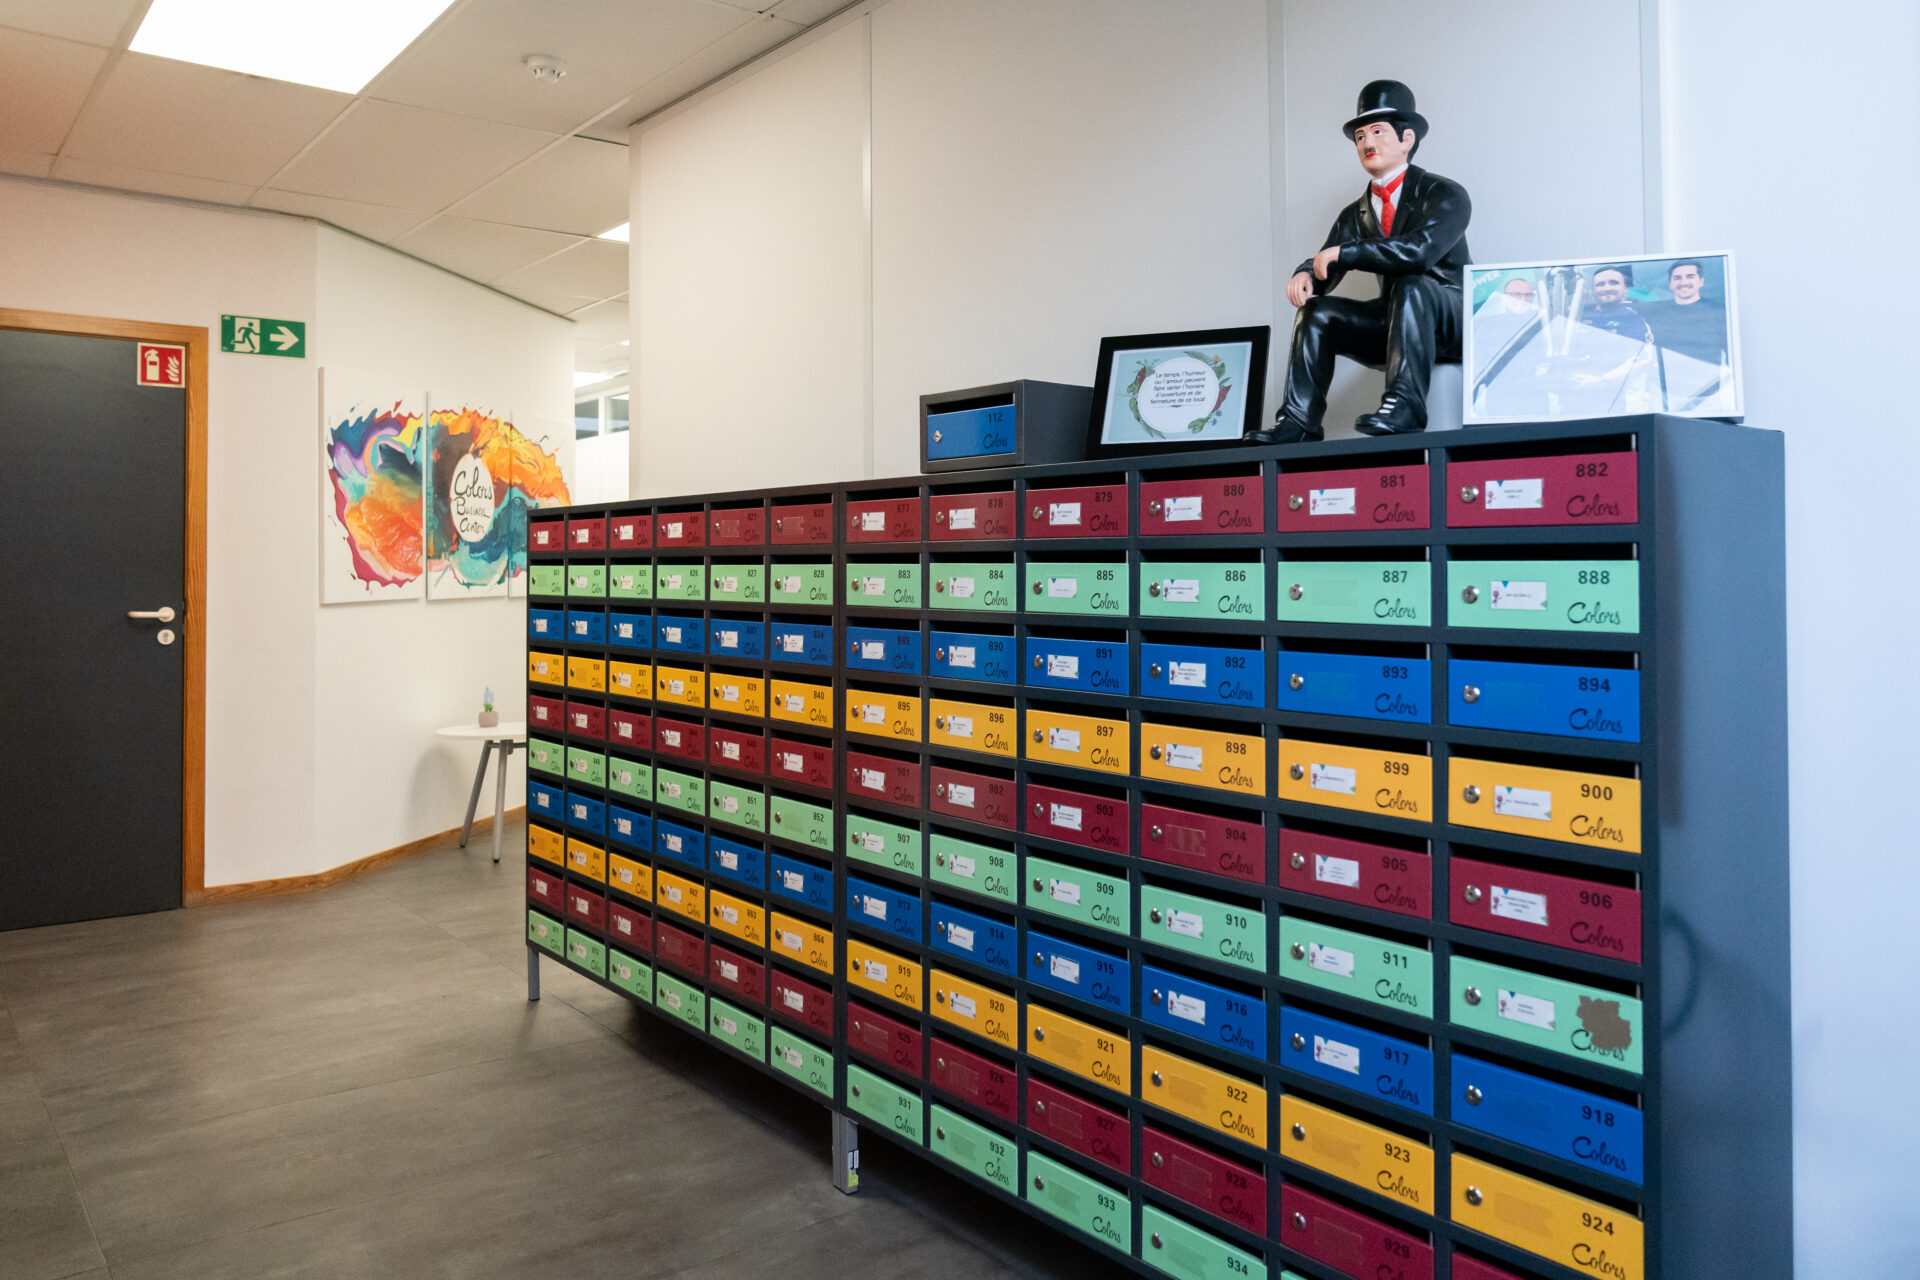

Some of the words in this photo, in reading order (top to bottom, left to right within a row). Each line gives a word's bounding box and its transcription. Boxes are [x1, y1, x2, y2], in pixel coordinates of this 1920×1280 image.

[988, 412, 1002, 423] 112
[983, 432, 1008, 449] Colors
[1575, 462, 1608, 478] 882
[454, 466, 493, 500] Colors
[1223, 484, 1245, 496] 880
[1380, 474, 1405, 488] 881
[988, 498, 1003, 508] 878
[1094, 491, 1112, 503] 879
[1566, 493, 1619, 517] Colors
[1217, 509, 1251, 528] Colors
[1373, 502, 1415, 523] Colors
[984, 519, 1009, 534] Colors
[1089, 514, 1118, 531] Colors
[897, 569, 910, 579] 883
[988, 569, 1003, 579] 884
[1096, 570, 1114, 580] 885
[1224, 570, 1246, 582] 886
[1382, 570, 1408, 583] 887
[1577, 570, 1610, 585] 888
[744, 586, 760, 598] Colors
[809, 587, 827, 600] Colors
[893, 589, 914, 603] Colors
[984, 590, 1008, 605] Colors
[1090, 592, 1119, 609] Colors
[1218, 595, 1252, 613] Colors
[1374, 598, 1416, 618] Colors
[1567, 601, 1620, 624] Colors
[988, 640, 1003, 652] 890
[1095, 647, 1112, 659] 891
[984, 661, 1008, 677] Colors
[1224, 655, 1245, 669] 892
[1090, 670, 1119, 688] Colors
[1382, 665, 1408, 680] 893
[1218, 681, 1252, 700] Colors
[1578, 676, 1610, 693] 894
[897, 700, 910, 711] 895
[1375, 693, 1417, 715] Colors
[809, 708, 828, 722] Colors
[989, 712, 1004, 724] 896
[1569, 707, 1622, 733] Colors
[893, 720, 914, 735] Colors
[1096, 725, 1113, 738] 897
[984, 733, 1008, 750] Colors
[1225, 741, 1246, 755] 898
[1091, 748, 1119, 767] Colors
[1218, 766, 1253, 787] Colors
[1383, 760, 1410, 776] 899
[988, 783, 1004, 796] 902
[1580, 783, 1613, 802] 900
[1376, 788, 1417, 812] Colors
[1095, 803, 1113, 817] 903
[744, 812, 760, 827] Colors
[1570, 814, 1623, 842] Colors
[809, 829, 828, 845] Colors
[897, 832, 910, 845] 907
[1091, 826, 1119, 846] Colors
[1225, 827, 1246, 843] 904
[893, 852, 914, 869] Colors
[988, 855, 1004, 868] 908
[1219, 852, 1253, 875] Colors
[1381, 855, 1408, 873] 905
[984, 876, 1009, 895] Colors
[1096, 881, 1114, 896] 909
[1374, 883, 1416, 909] Colors
[1579, 889, 1612, 910] 906
[1091, 904, 1120, 926] Colors
[1225, 913, 1247, 930] 910
[1570, 921, 1623, 951] Colors
[809, 950, 828, 968] Colors
[985, 947, 1009, 968] Colors
[1219, 938, 1253, 962] Colors
[1096, 959, 1114, 976] 915
[1382, 950, 1407, 969] 911
[897, 964, 911, 978] 919
[894, 983, 915, 1003] Colors
[1091, 982, 1120, 1005] Colors
[1375, 978, 1417, 1006] Colors
[989, 998, 1004, 1014] 920
[1225, 998, 1247, 1017] 916
[985, 1019, 1009, 1041] Colors
[1220, 1024, 1254, 1050] Colors
[1097, 1037, 1114, 1054] 921
[1383, 1046, 1409, 1067] 917
[809, 1071, 828, 1091] Colors
[1091, 1060, 1120, 1085] Colors
[1226, 1084, 1247, 1104] 922
[1376, 1074, 1418, 1104] Colors
[898, 1095, 910, 1111] 931
[894, 1114, 915, 1136] Colors
[1096, 1114, 1115, 1134] 927
[1220, 1110, 1254, 1137] Colors
[1581, 1104, 1614, 1128] 918
[989, 1140, 1004, 1157] 932
[1091, 1138, 1120, 1164] Colors
[1384, 1141, 1410, 1164] 923
[1573, 1136, 1625, 1170] Colors
[985, 1160, 1009, 1185] Colors
[1225, 1170, 1247, 1191] 928
[1377, 1169, 1418, 1201] Colors
[1097, 1193, 1115, 1212] 933
[1219, 1194, 1254, 1224] Colors
[1092, 1215, 1121, 1242] Colors
[1581, 1211, 1614, 1237] 924
[1383, 1236, 1410, 1261] 929
[1227, 1254, 1249, 1276] 934
[1572, 1243, 1625, 1280] Colors
